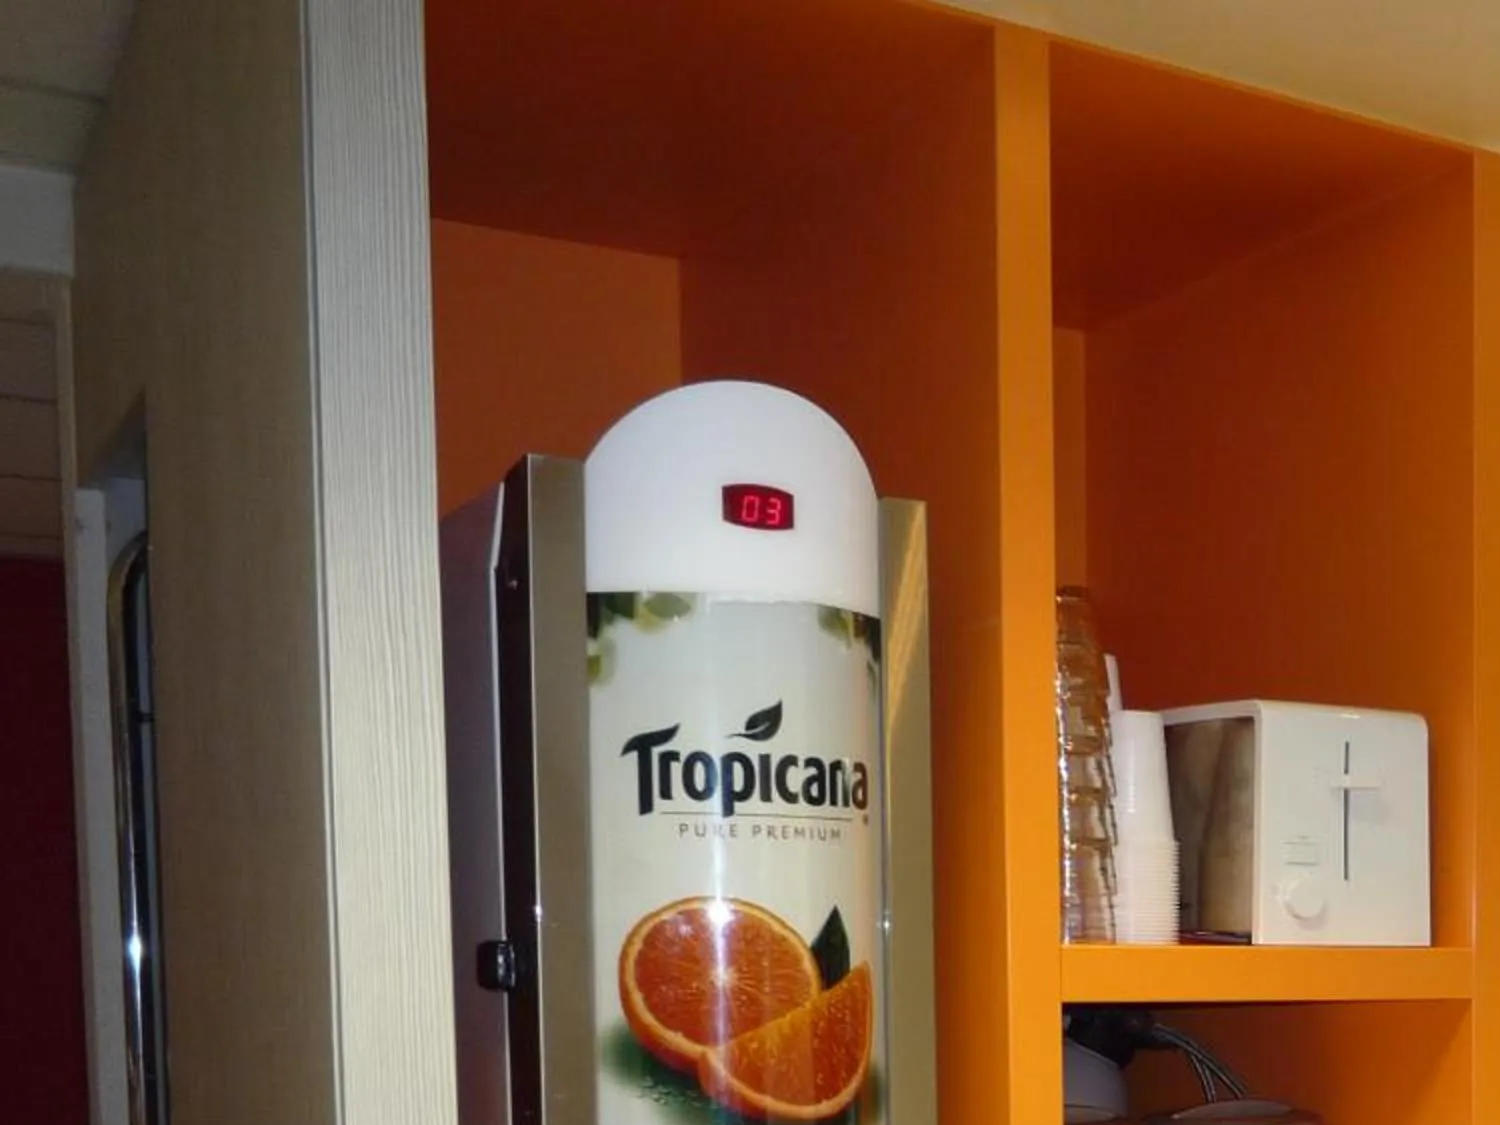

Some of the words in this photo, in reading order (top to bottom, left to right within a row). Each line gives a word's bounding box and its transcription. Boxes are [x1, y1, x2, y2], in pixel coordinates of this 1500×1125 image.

[742, 495, 781, 525] 03
[620, 722, 869, 818] Tropicana
[678, 822, 738, 839] PURE
[752, 824, 842, 842] PREMIUM
